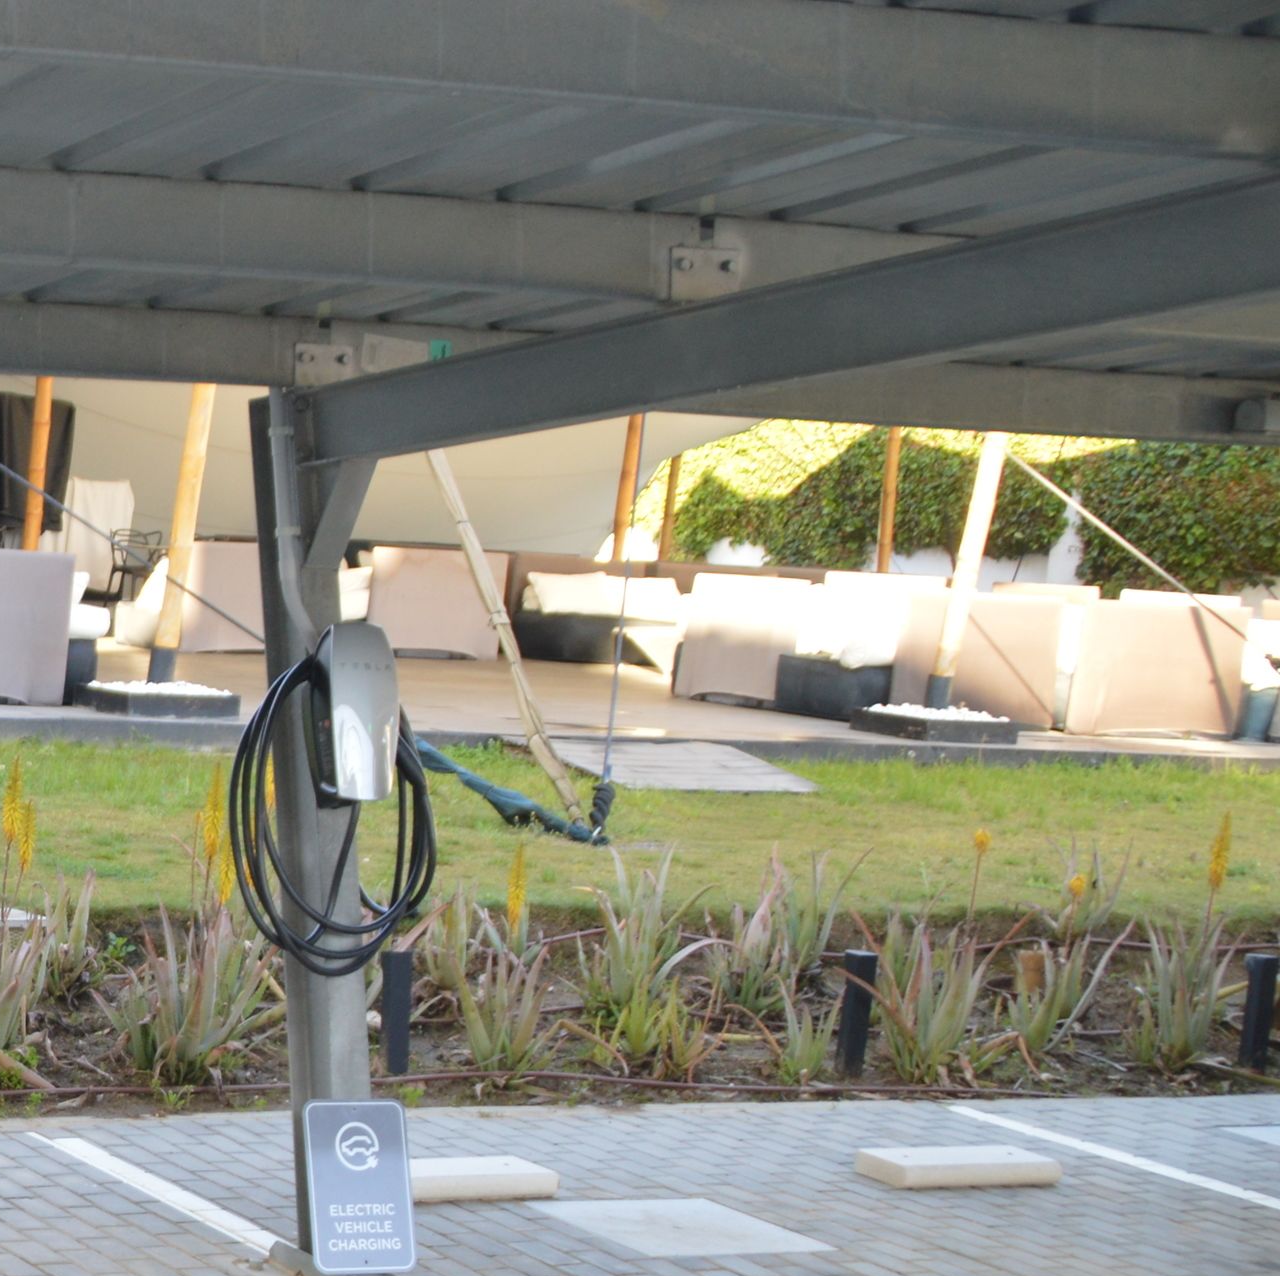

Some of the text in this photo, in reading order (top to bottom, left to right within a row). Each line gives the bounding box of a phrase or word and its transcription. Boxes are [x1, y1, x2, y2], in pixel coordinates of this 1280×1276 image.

[329, 1203, 395, 1217] ELECTRIC
[335, 1220, 393, 1234] VEHICLE
[328, 1237, 402, 1251] CHARGING
